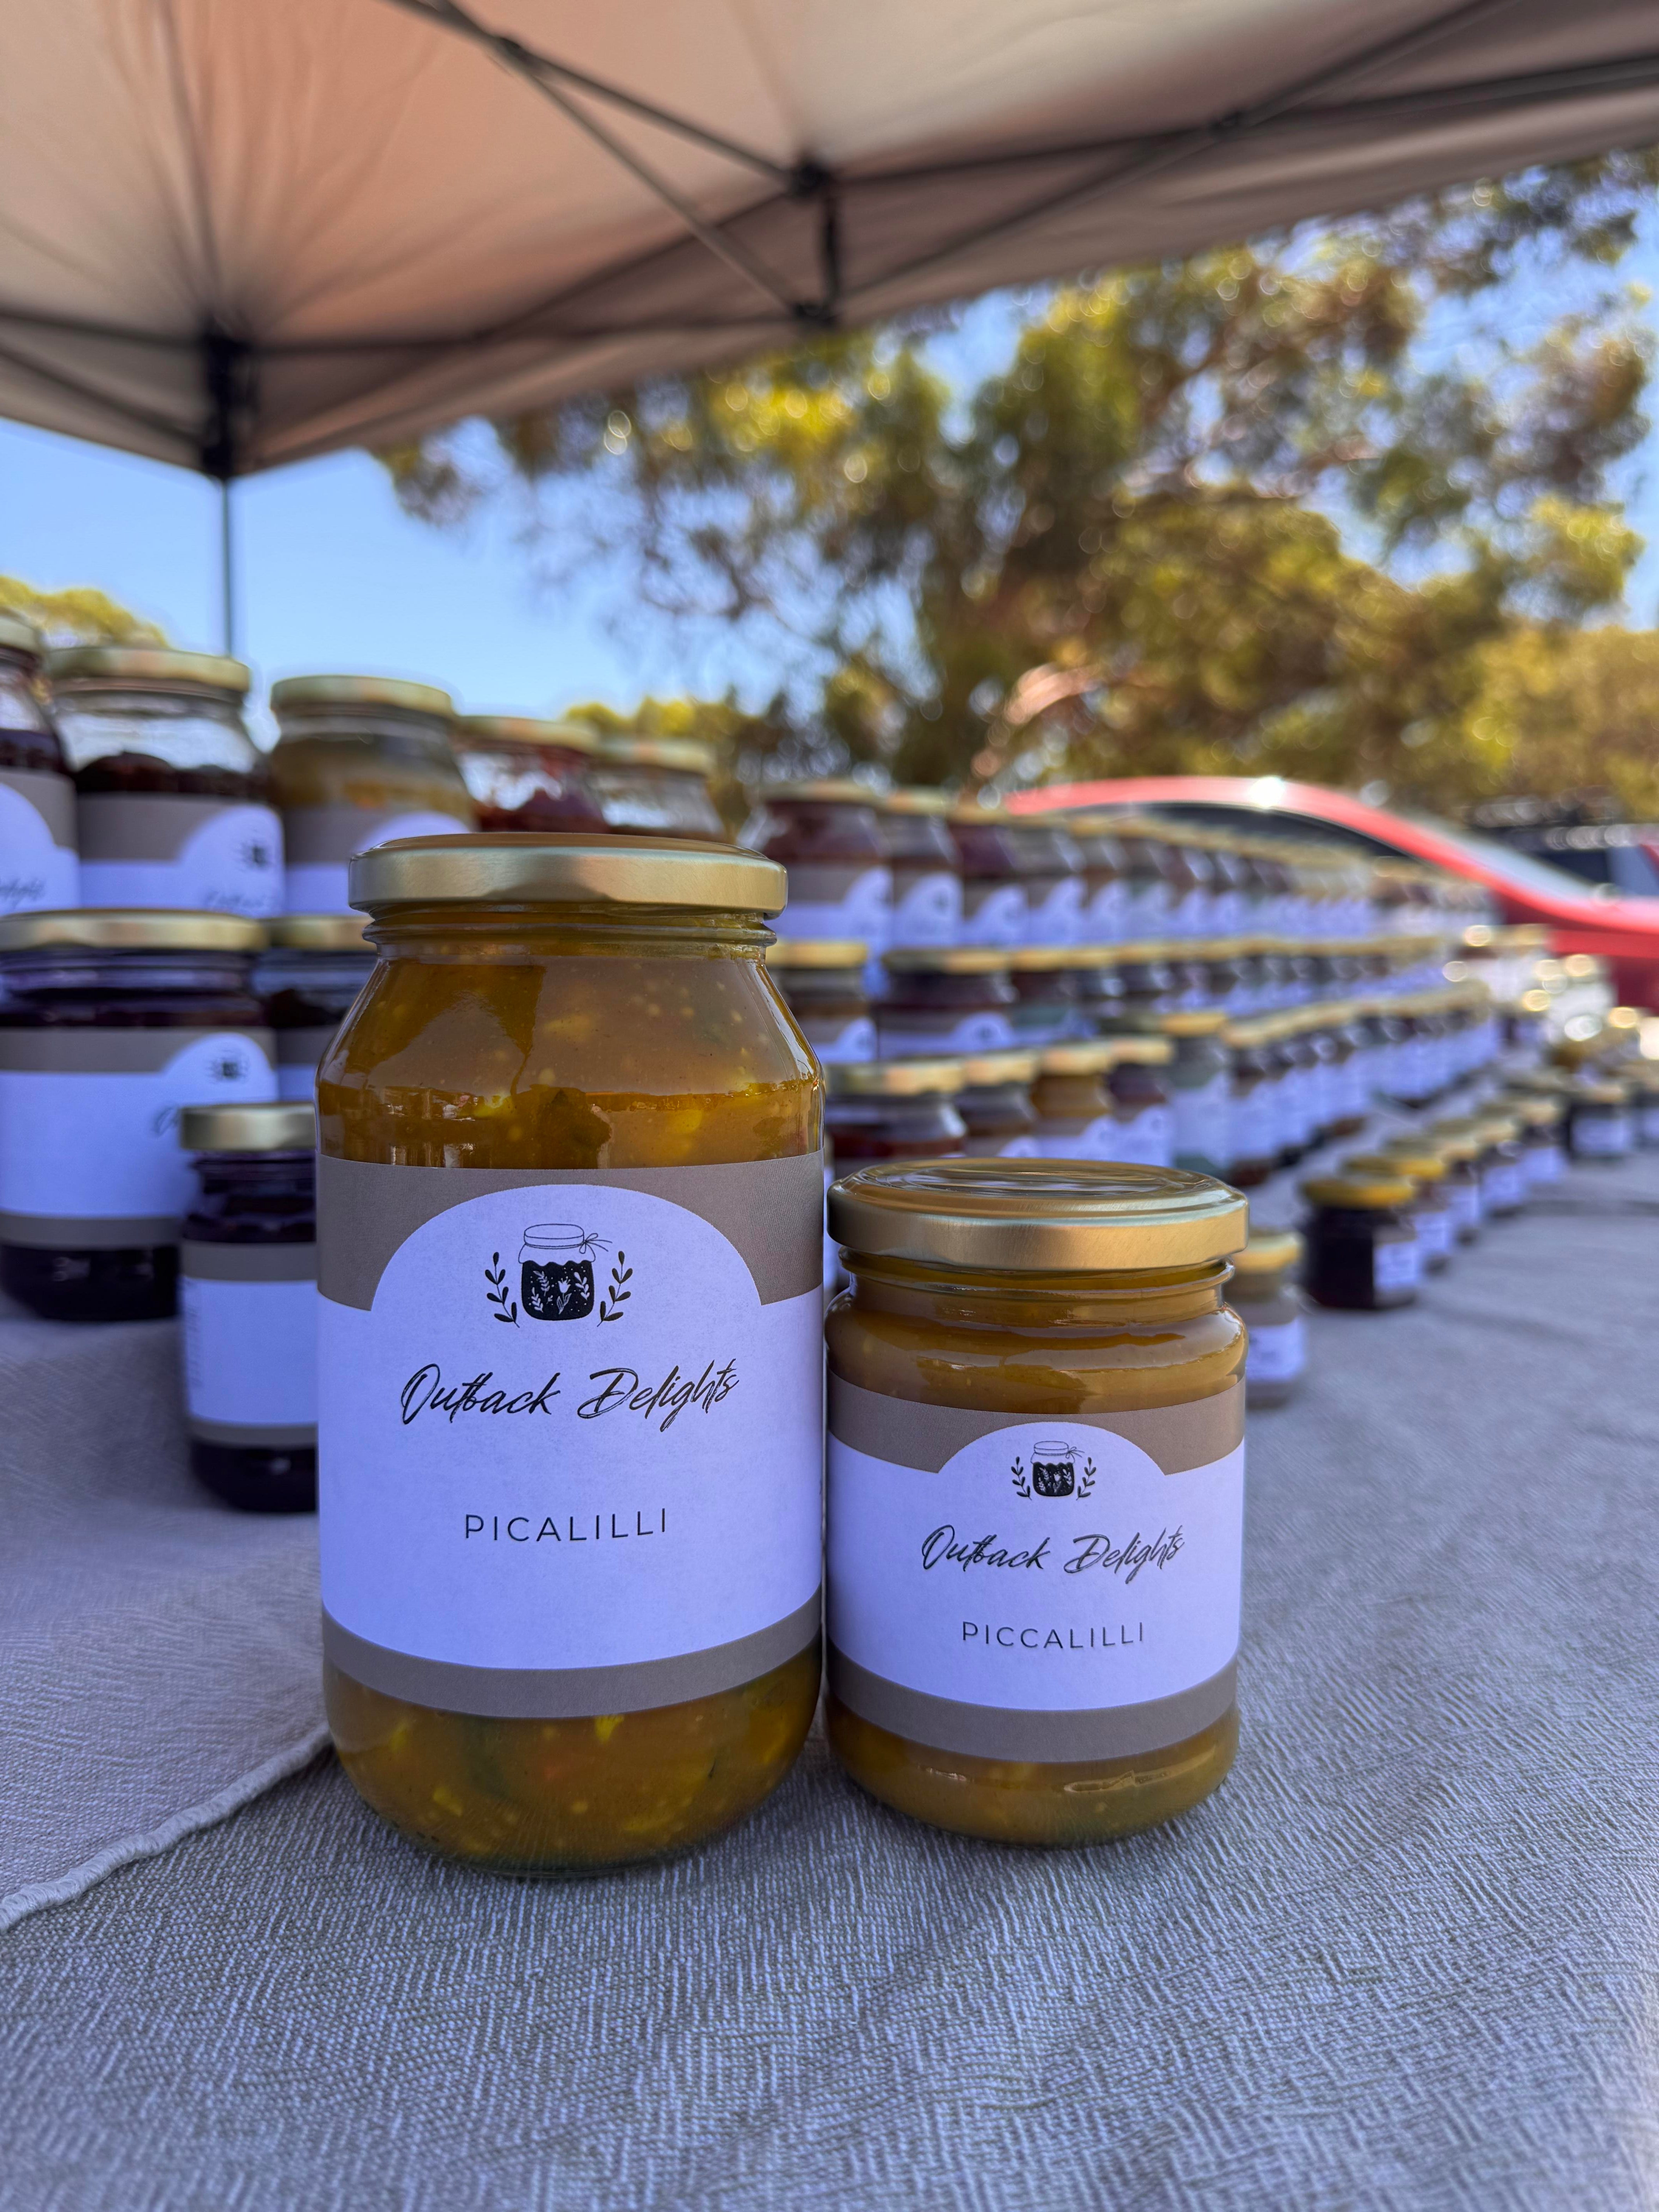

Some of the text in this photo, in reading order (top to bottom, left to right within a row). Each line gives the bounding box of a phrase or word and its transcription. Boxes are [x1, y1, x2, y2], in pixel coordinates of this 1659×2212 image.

[400, 1358, 740, 1432] Outback Delights
[465, 1507, 666, 1542] PICALILLI
[921, 1524, 1185, 1585] Outback Delights
[962, 1621, 1143, 1649] PICCALILLI
